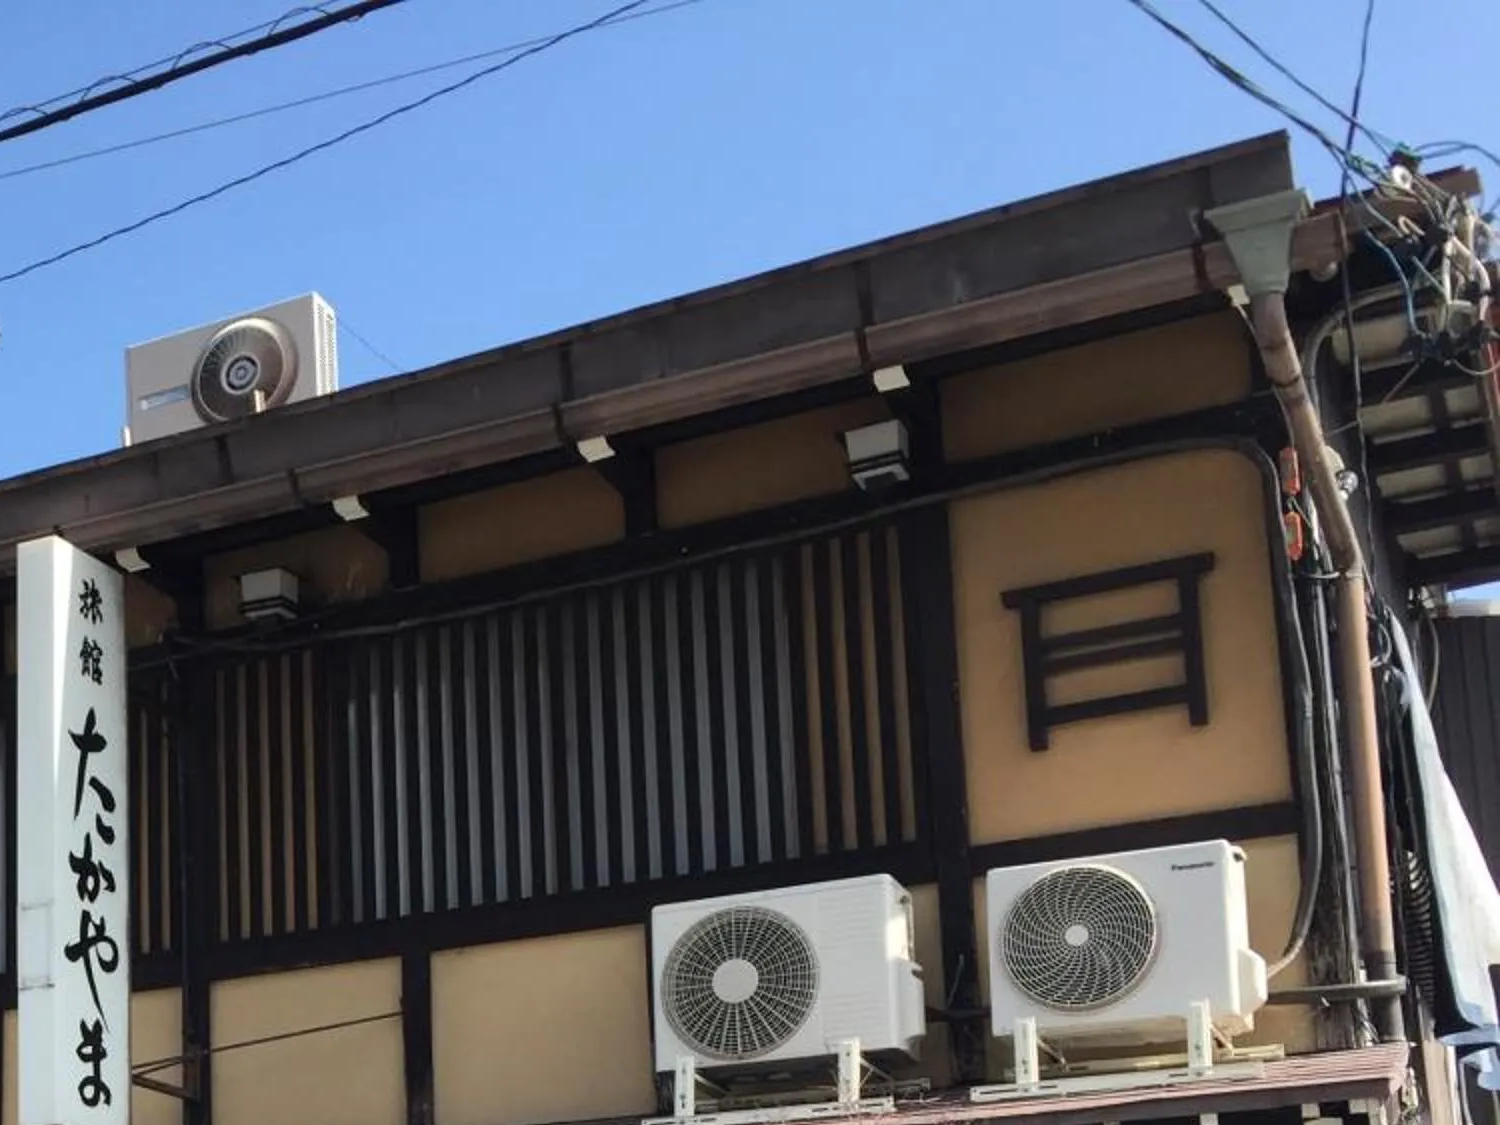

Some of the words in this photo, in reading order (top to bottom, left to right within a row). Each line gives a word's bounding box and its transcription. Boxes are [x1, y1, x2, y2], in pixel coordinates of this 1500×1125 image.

[79, 578, 103, 686] 旅館
[64, 706, 120, 1109] たかやま
